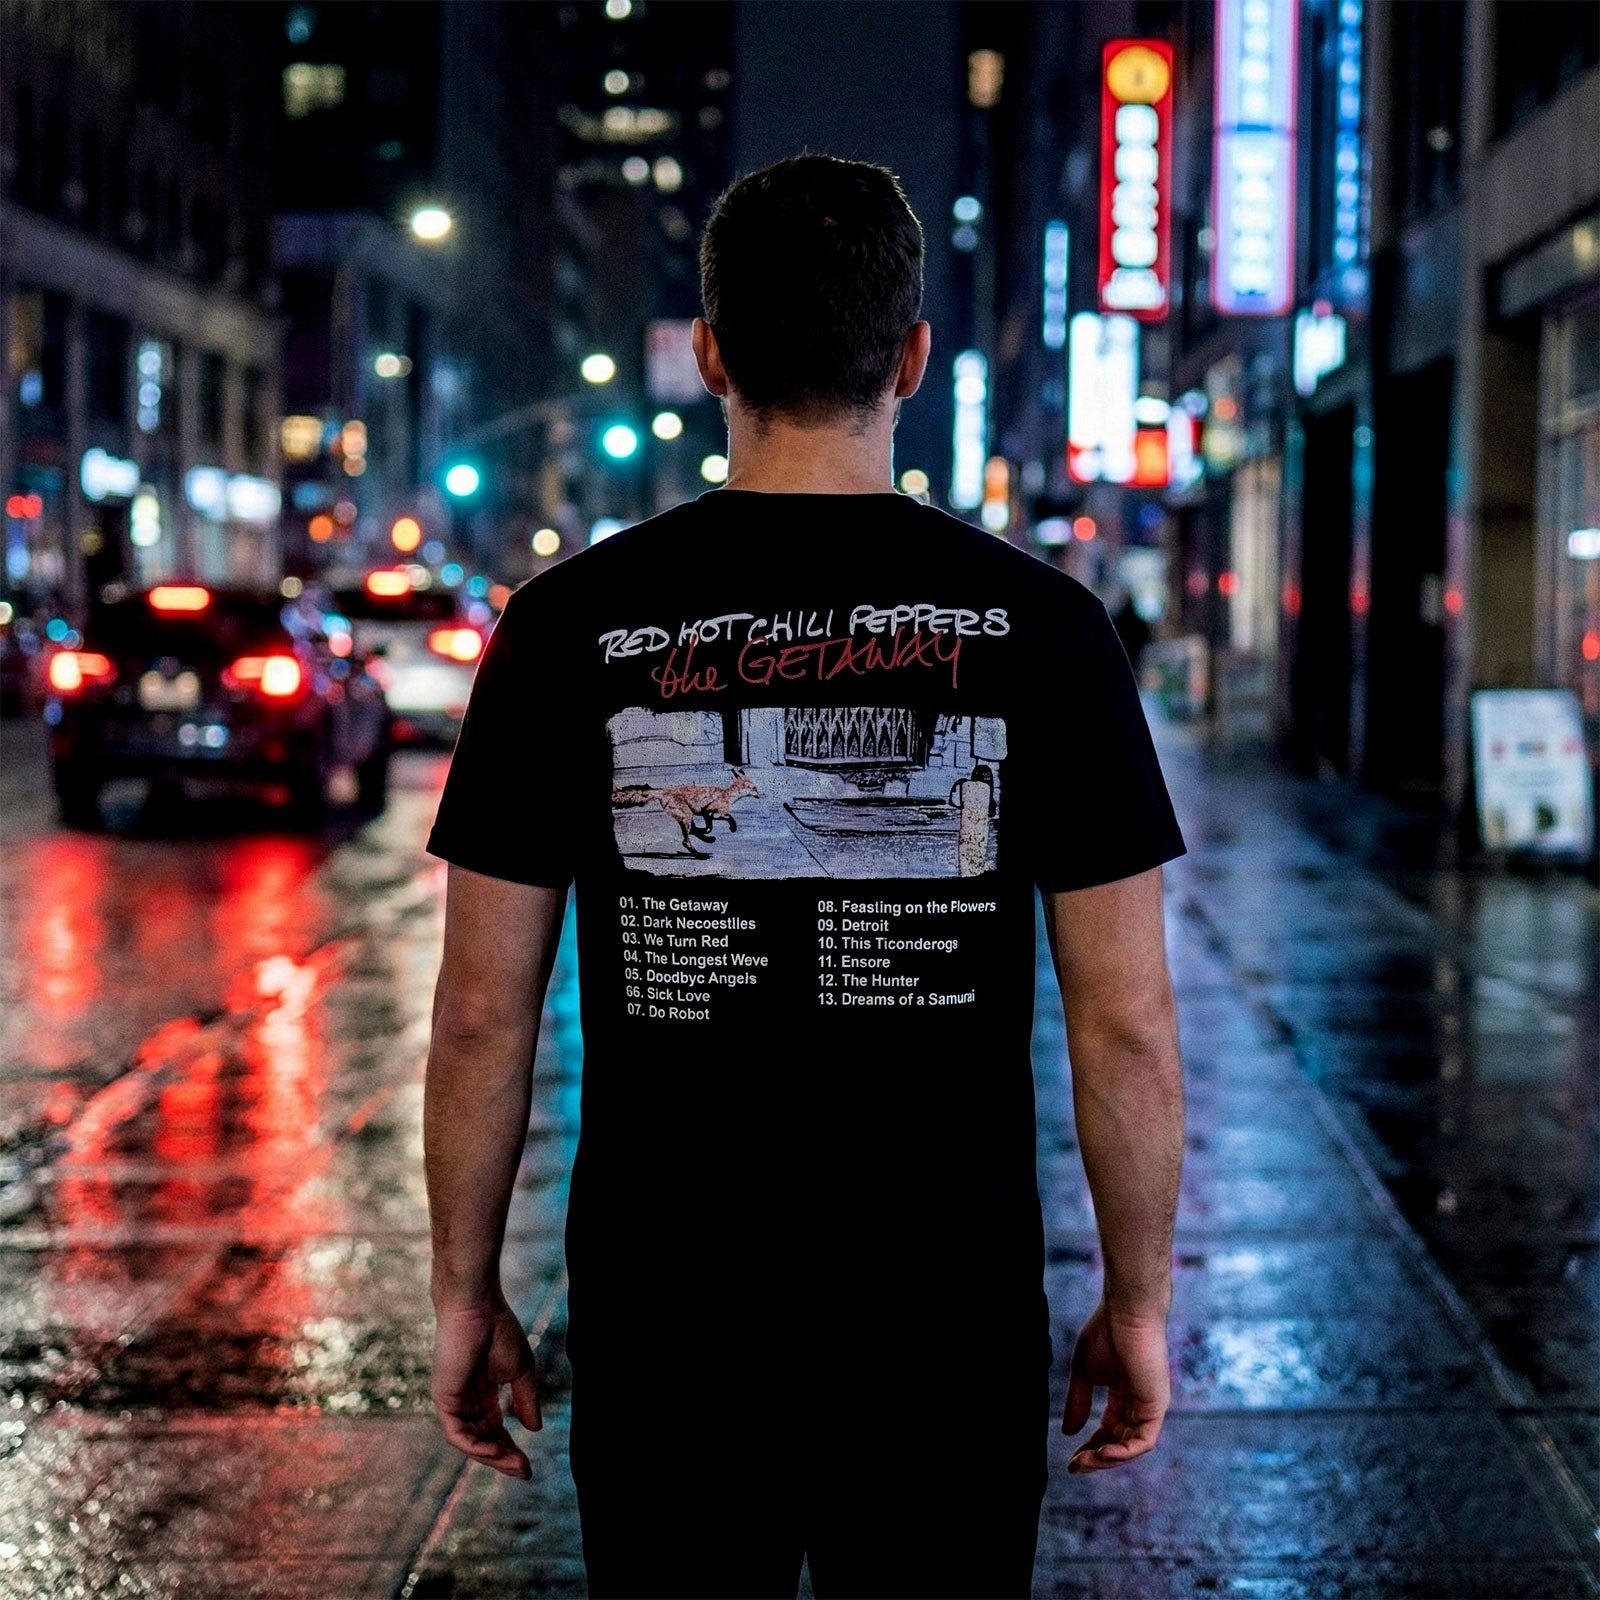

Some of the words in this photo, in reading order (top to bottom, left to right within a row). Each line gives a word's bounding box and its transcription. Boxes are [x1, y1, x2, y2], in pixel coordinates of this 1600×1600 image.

[599, 627, 669, 663] RED
[678, 613, 754, 646] HOT
[748, 609, 833, 644] CHILI
[849, 603, 1010, 636] PEPPERS
[651, 634, 727, 698] the
[737, 626, 962, 688] GETAWAY
[620, 896, 638, 908] 01.
[642, 897, 665, 910] The
[670, 898, 728, 914] Getaway
[818, 900, 837, 912] 08.
[905, 904, 922, 913] on
[927, 901, 947, 913] the
[951, 900, 996, 912] Flowers
[621, 915, 639, 926] 02.
[643, 916, 672, 928] Dark
[818, 919, 837, 931] 09.
[842, 919, 889, 931] Detroit
[623, 932, 640, 944] 03.
[644, 933, 663, 946] We
[667, 935, 696, 947] Turn
[702, 935, 728, 947] Red
[818, 937, 837, 949] 10.
[842, 937, 871, 949] This
[624, 950, 641, 962] 04.
[645, 951, 667, 964] The
[672, 953, 727, 969] Longest
[818, 955, 836, 967] 11.
[842, 955, 890, 968] Ensore
[625, 968, 642, 980] 05.
[708, 972, 756, 987] Angels
[818, 974, 837, 986] 12.
[842, 974, 867, 986] The
[872, 974, 919, 987] Hunter
[648, 987, 673, 1001] Sick
[678, 990, 710, 1002] Love
[818, 993, 837, 1005] 13.
[842, 993, 894, 1005] Dreams
[899, 993, 913, 1005] of
[917, 996, 924, 1005] a
[929, 989, 975, 1005] Samurai
[628, 1003, 645, 1016] 07.
[649, 1005, 665, 1018] Do
[669, 1007, 709, 1020] Robot
